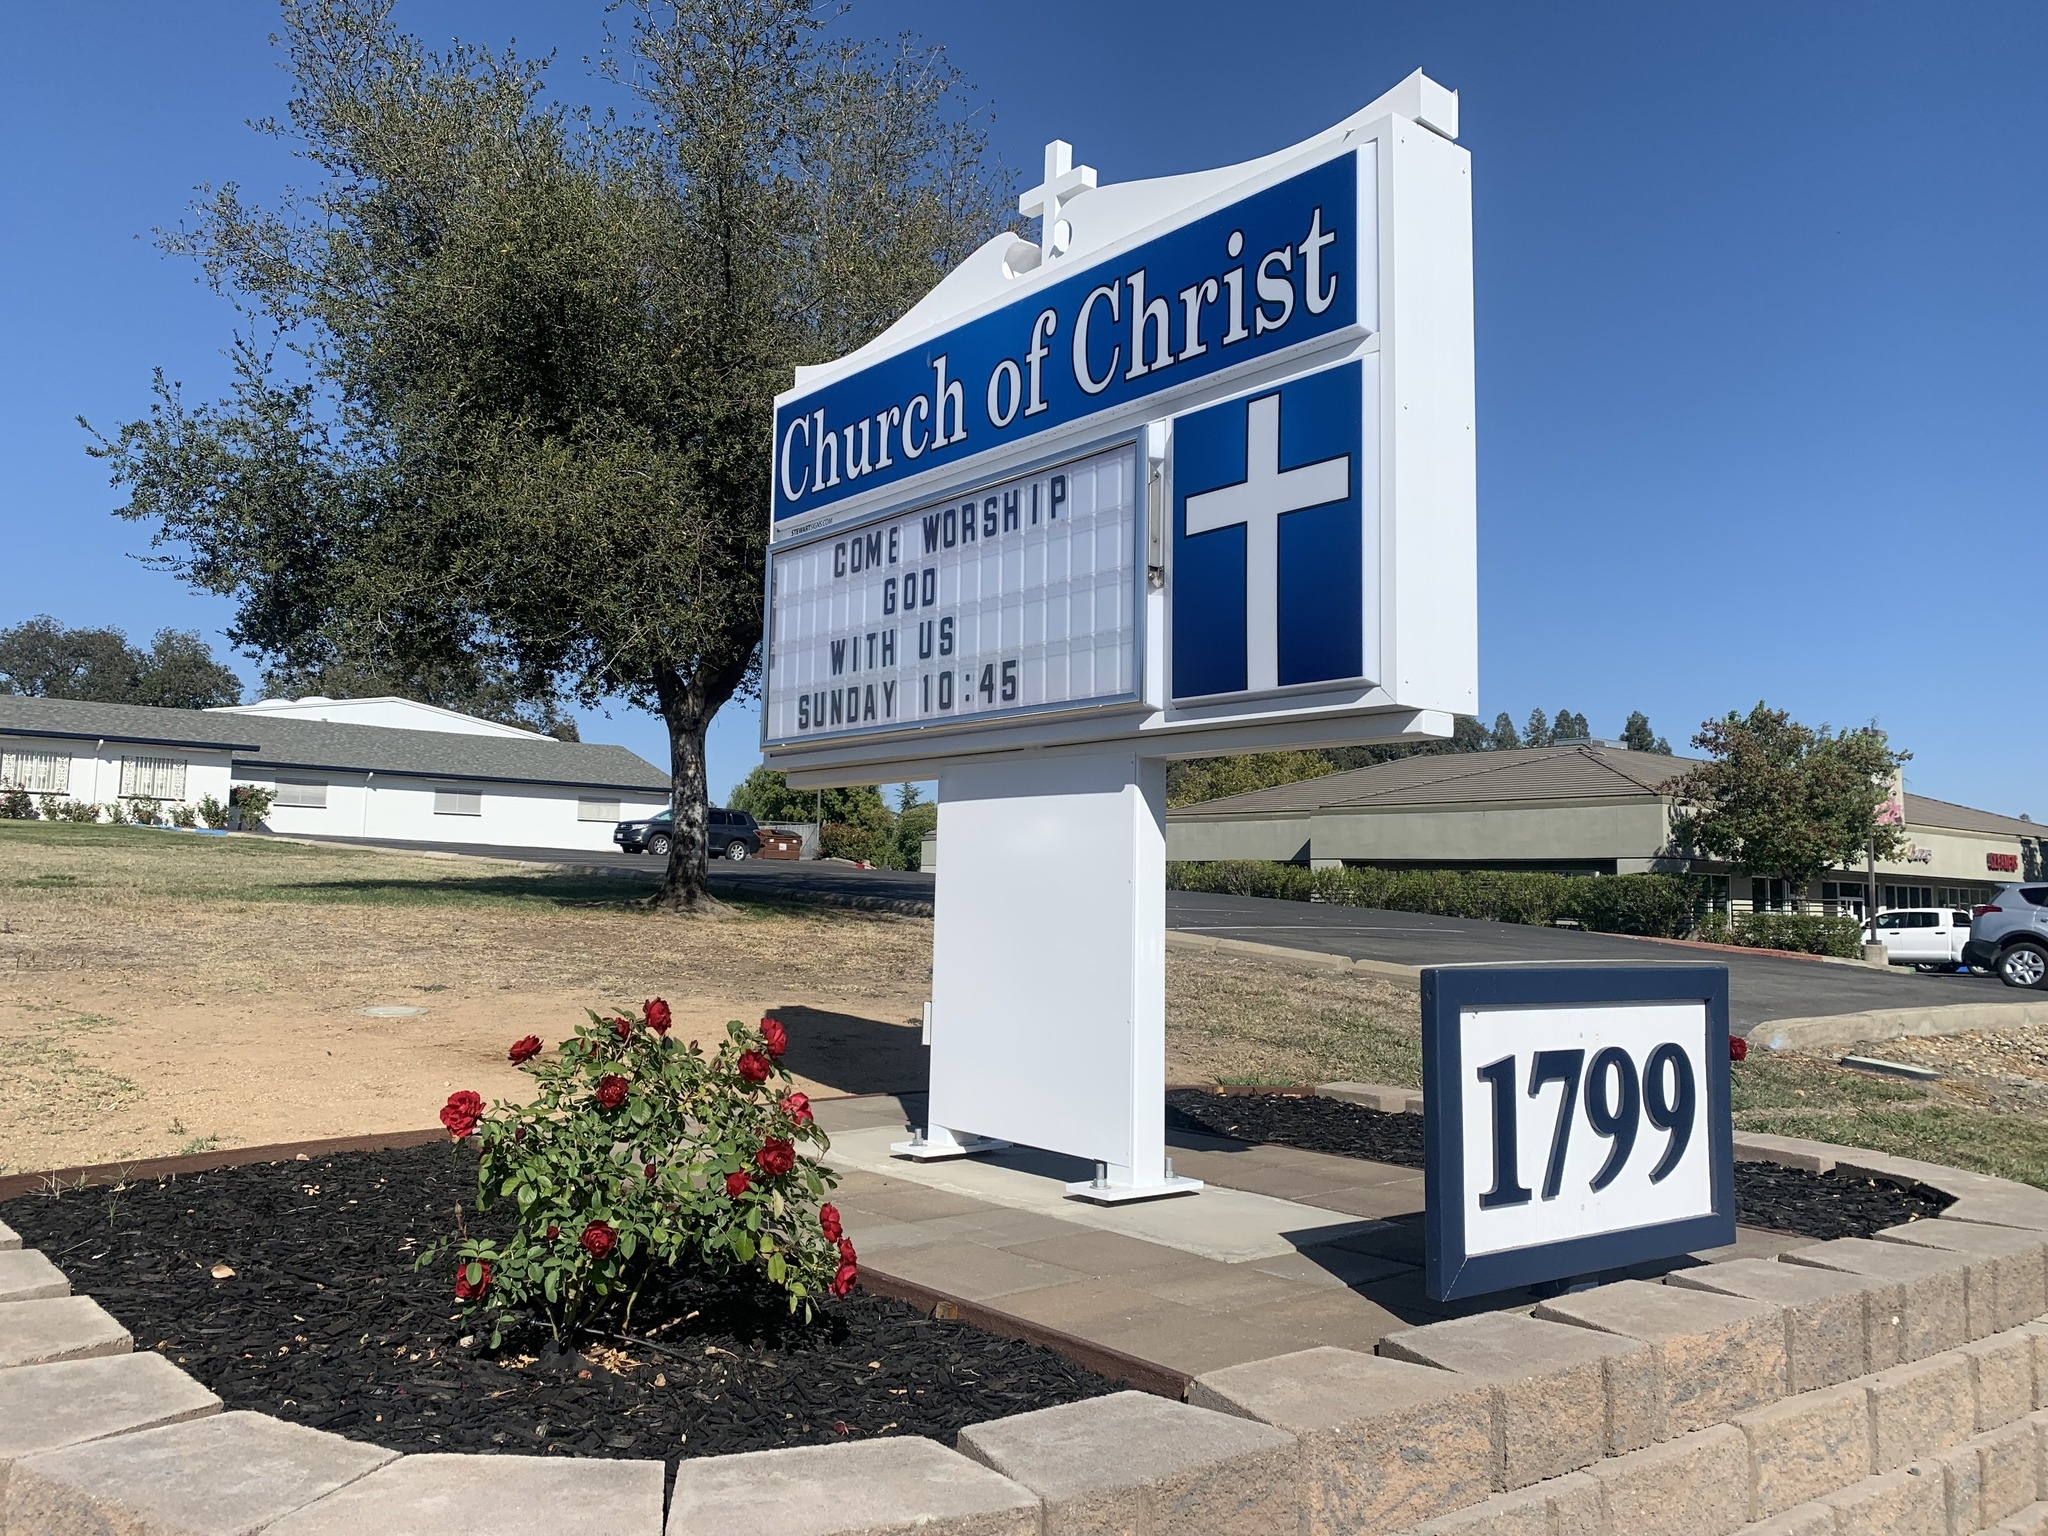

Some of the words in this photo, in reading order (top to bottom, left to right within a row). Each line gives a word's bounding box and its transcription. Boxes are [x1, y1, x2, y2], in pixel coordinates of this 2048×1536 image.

[779, 354, 968, 503] Church
[987, 306, 1058, 428] of
[1072, 205, 1338, 396] Christ
[791, 517, 833, 536] STEWARTSIGNS.COM
[834, 526, 898, 578] COME
[922, 475, 1066, 553] WORSHIP
[883, 567, 936, 615] GOD
[831, 628, 895, 675] WITH
[919, 616, 954, 659] US
[798, 680, 896, 729] SUNDAY
[923, 660, 1017, 712] 10:45
[1477, 1042, 1696, 1211] 1799
